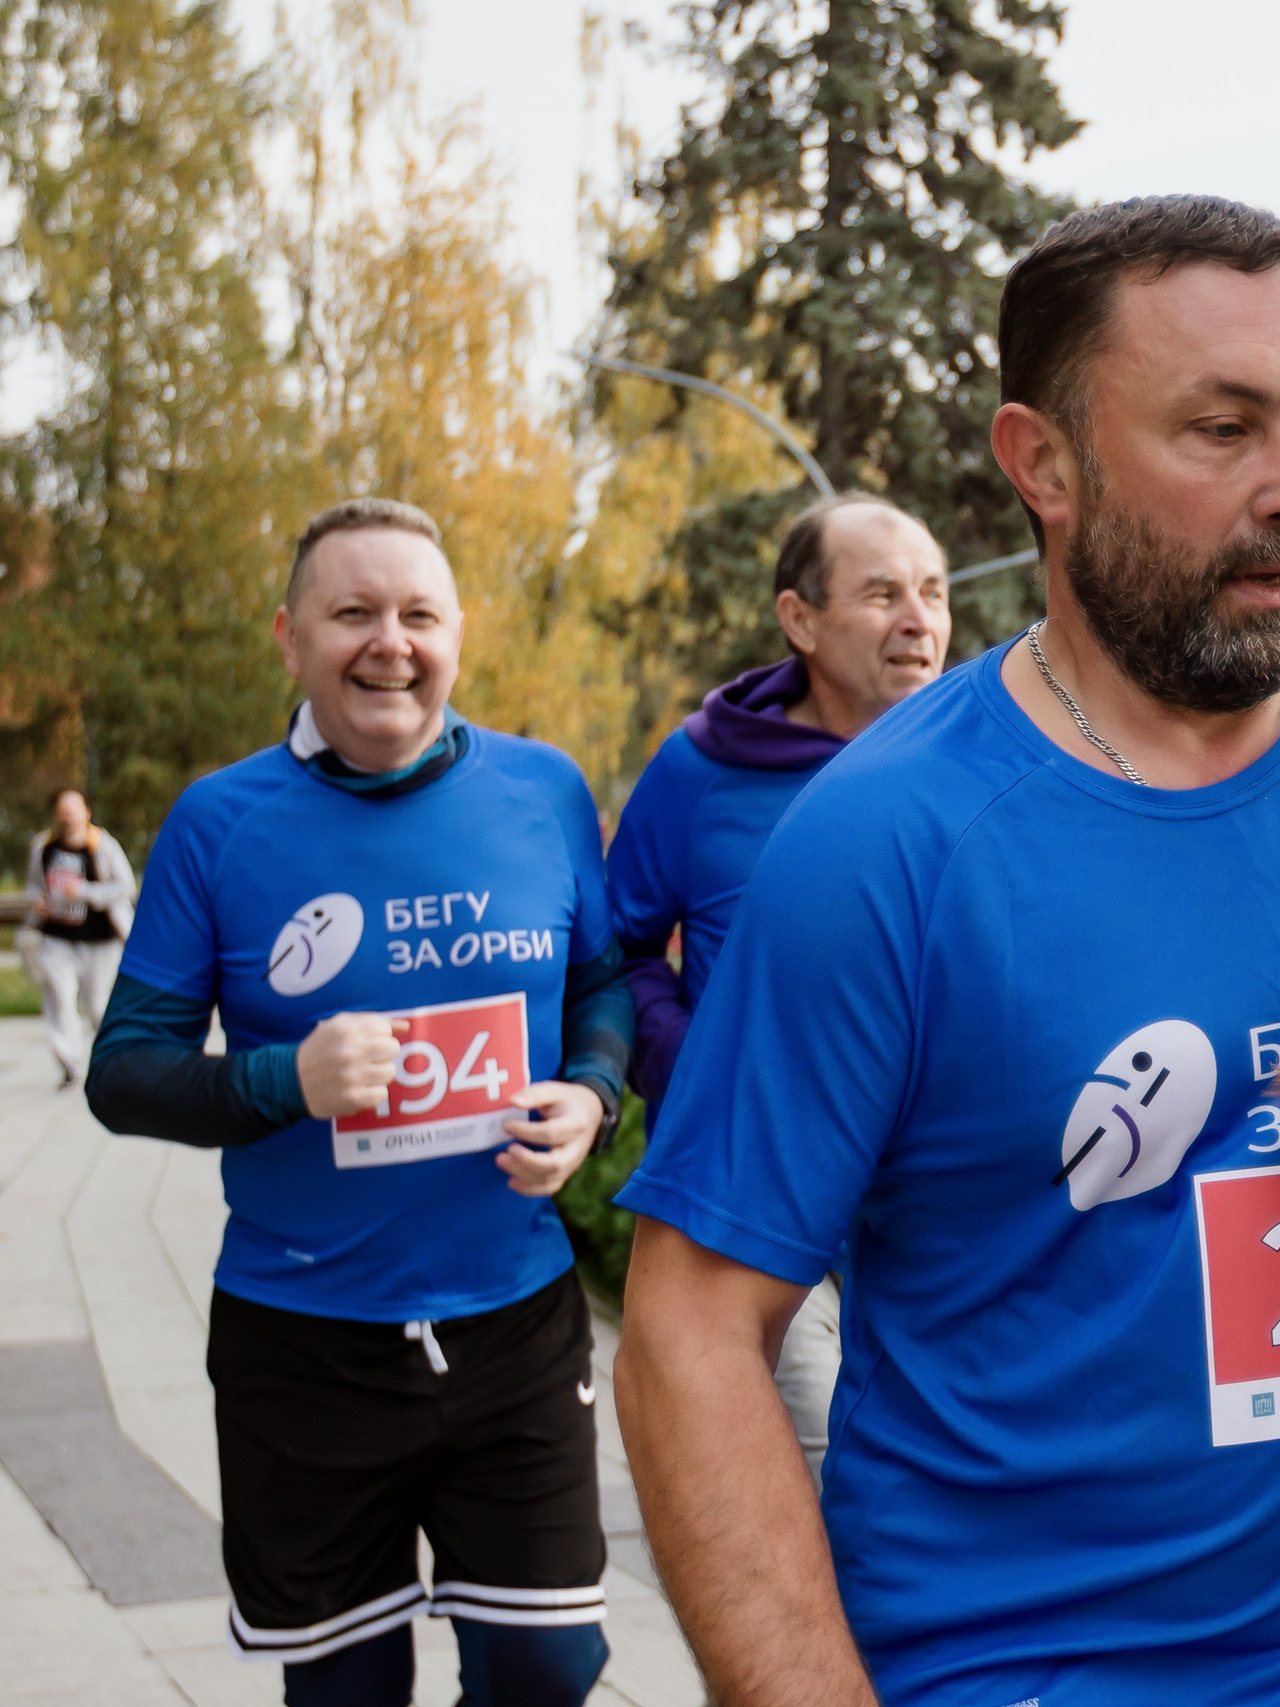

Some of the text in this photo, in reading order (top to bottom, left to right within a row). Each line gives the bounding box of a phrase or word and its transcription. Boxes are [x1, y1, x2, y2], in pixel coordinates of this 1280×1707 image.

[384, 889, 490, 933] БЕГУ
[386, 929, 554, 974] ЗА ОРБИ
[375, 1030, 509, 1118] 94
